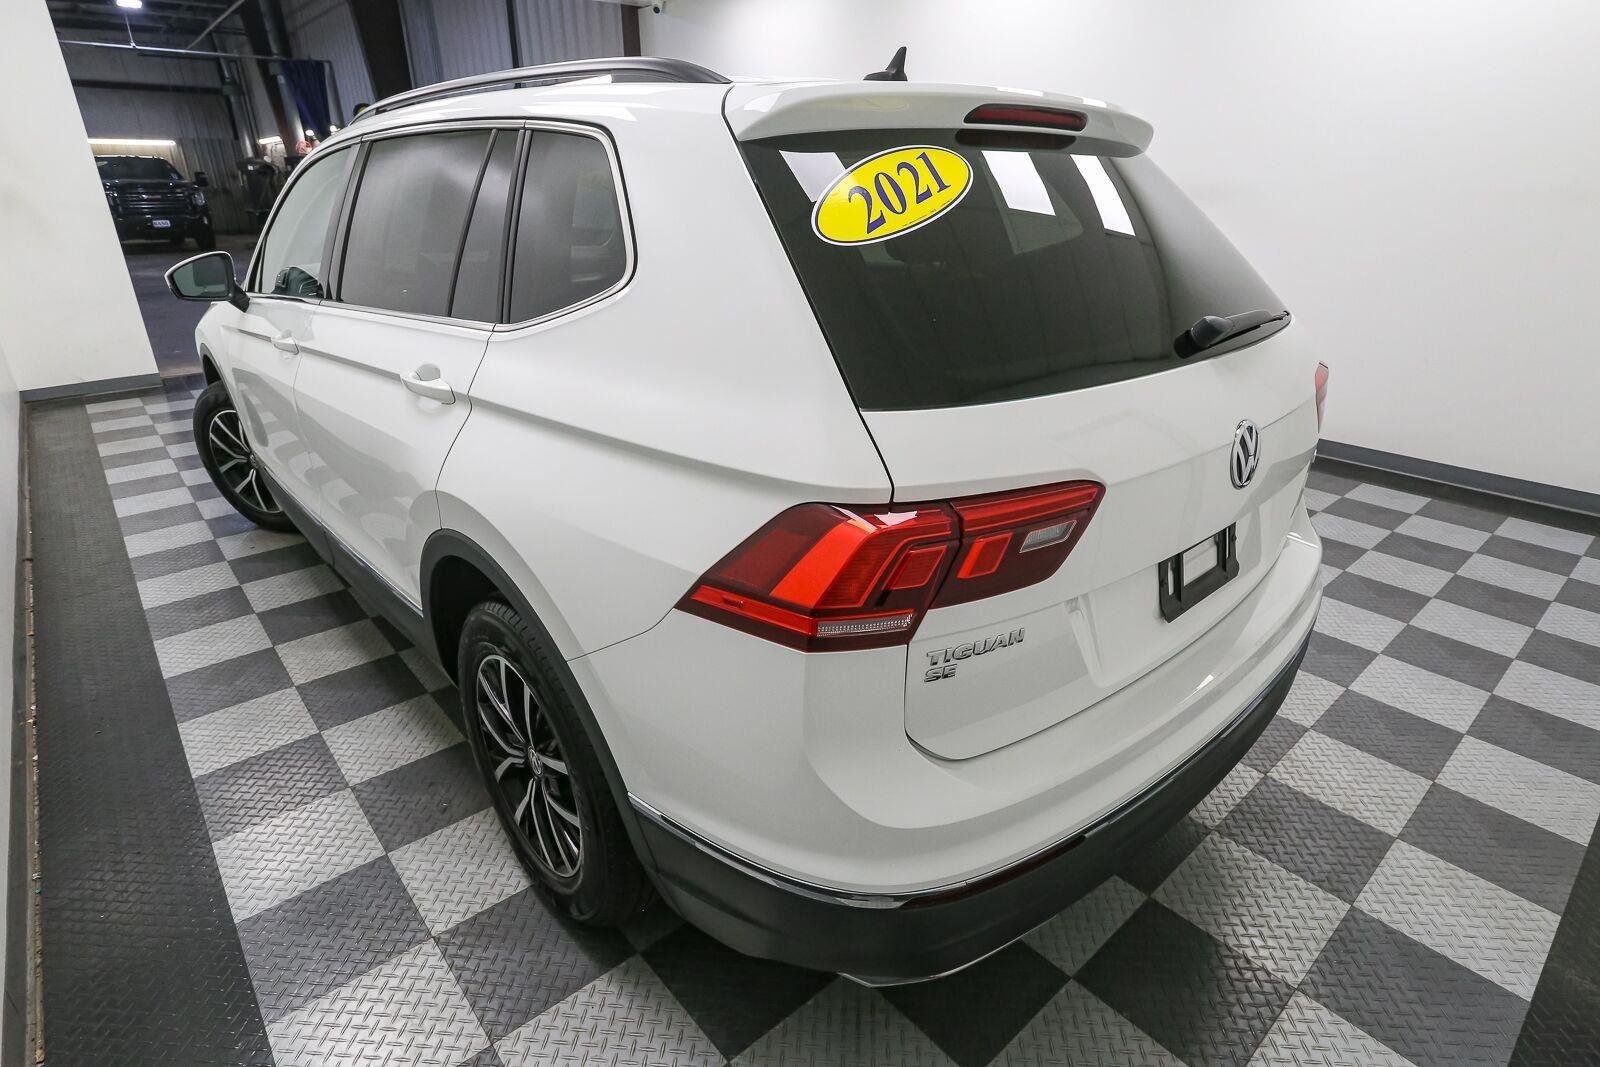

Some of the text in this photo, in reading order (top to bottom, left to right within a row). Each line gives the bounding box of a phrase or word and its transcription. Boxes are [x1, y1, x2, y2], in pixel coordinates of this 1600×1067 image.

[848, 151, 952, 235] 2021
[926, 627, 1026, 666] TIGUAN
[924, 663, 958, 683] SE
